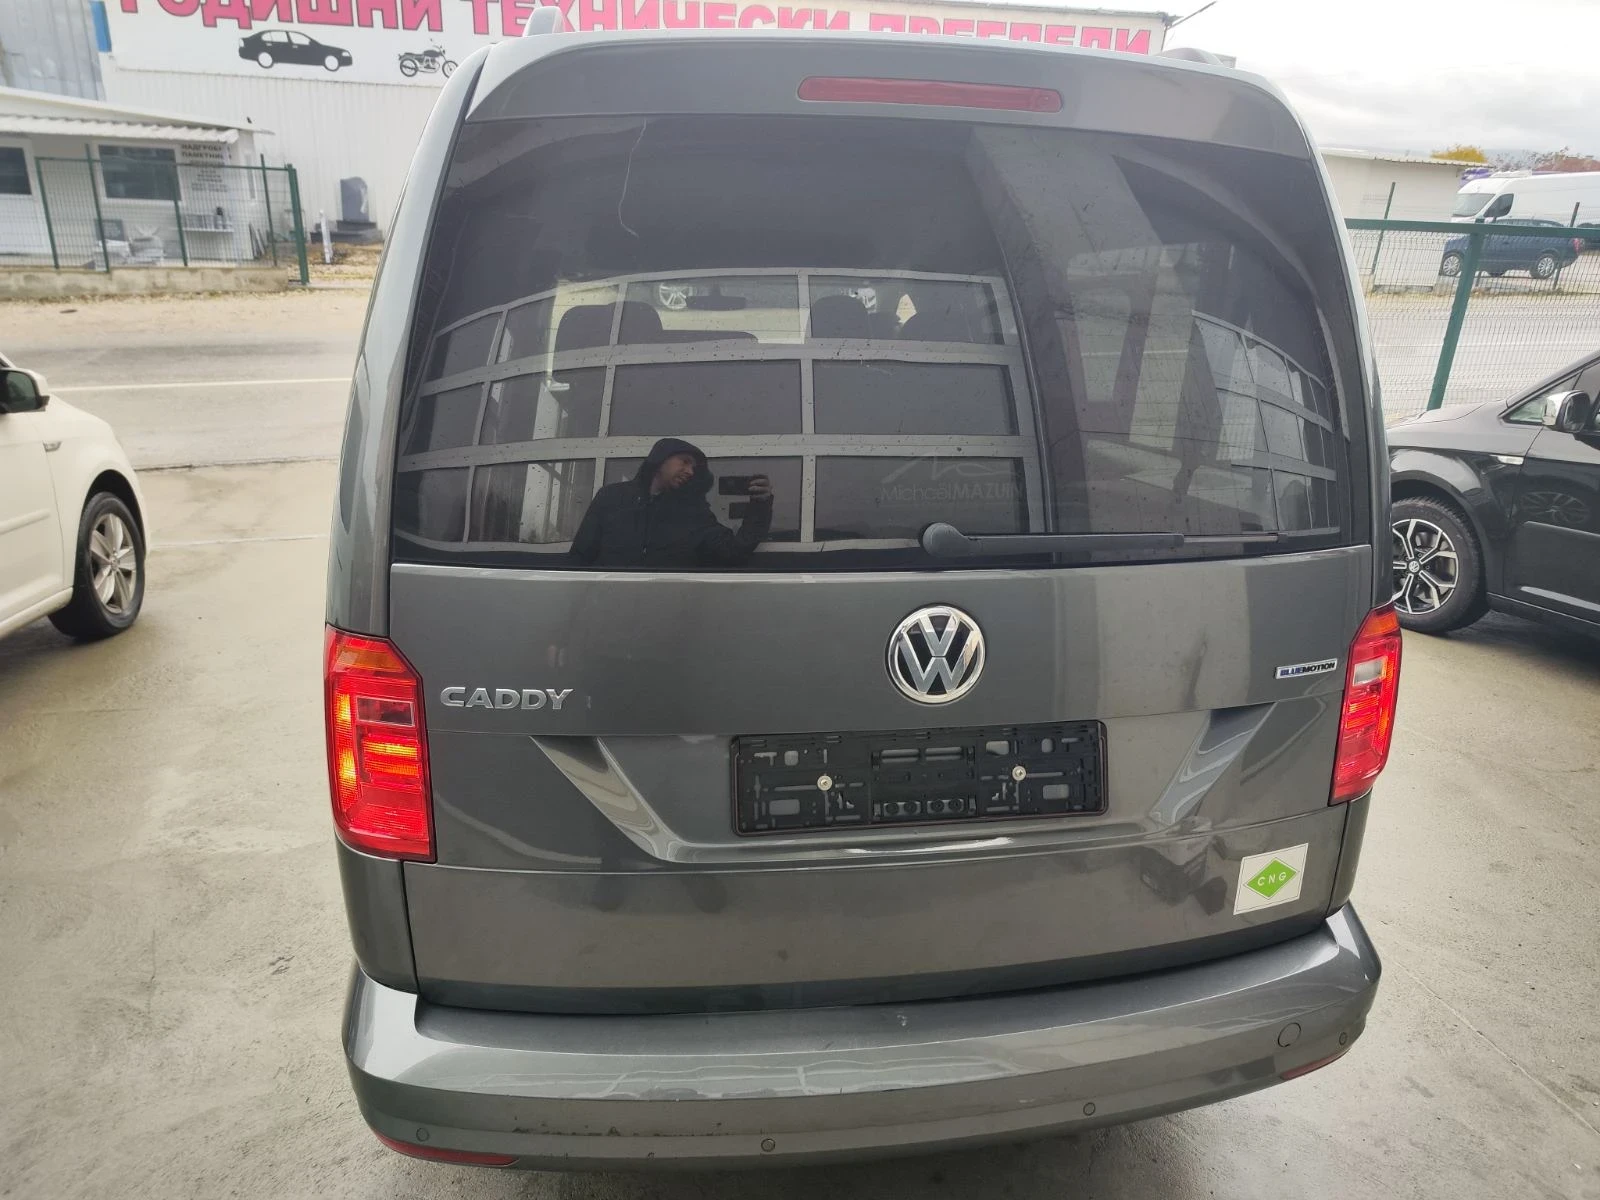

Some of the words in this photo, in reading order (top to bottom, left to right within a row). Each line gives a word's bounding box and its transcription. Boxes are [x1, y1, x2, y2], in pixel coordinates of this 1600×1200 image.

[120, 0, 444, 32] ДИШНИ
[181, 143, 232, 152] НАДГРОБ
[1280, 661, 1336, 677] BLUEMOTION
[440, 686, 574, 710] CADDY
[1257, 871, 1287, 886] CNG
